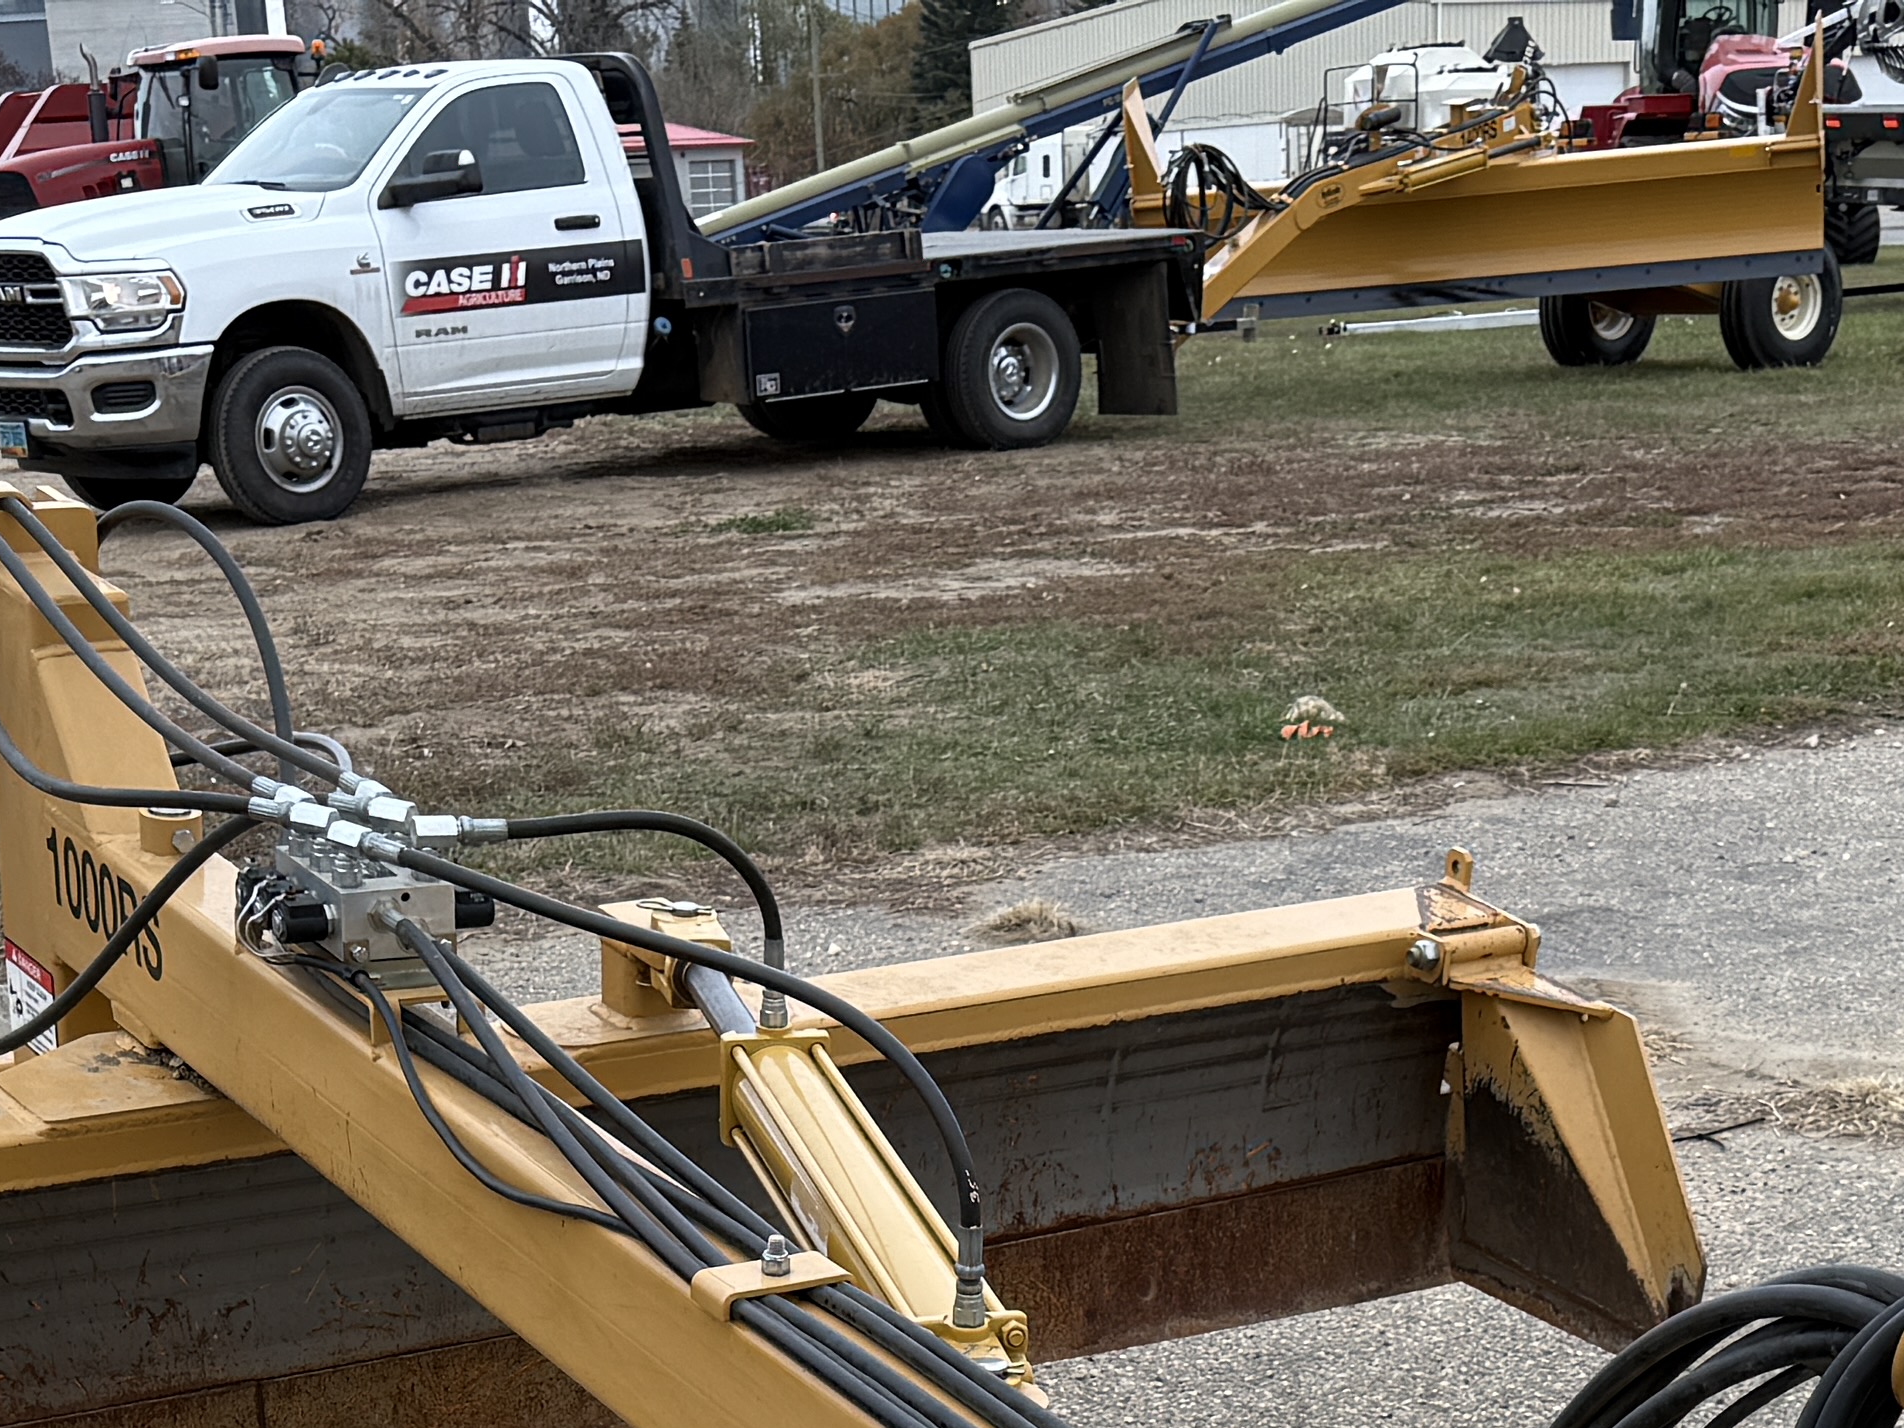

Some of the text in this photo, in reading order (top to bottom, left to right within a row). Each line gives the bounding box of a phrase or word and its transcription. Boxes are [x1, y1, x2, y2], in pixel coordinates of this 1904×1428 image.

[110, 150, 138, 162] CASE
[548, 261, 587, 273] Northern
[405, 265, 494, 297] CASE
[596, 269, 611, 281] ND
[458, 288, 526, 307] AGRICULTURE
[415, 325, 469, 339] RAM
